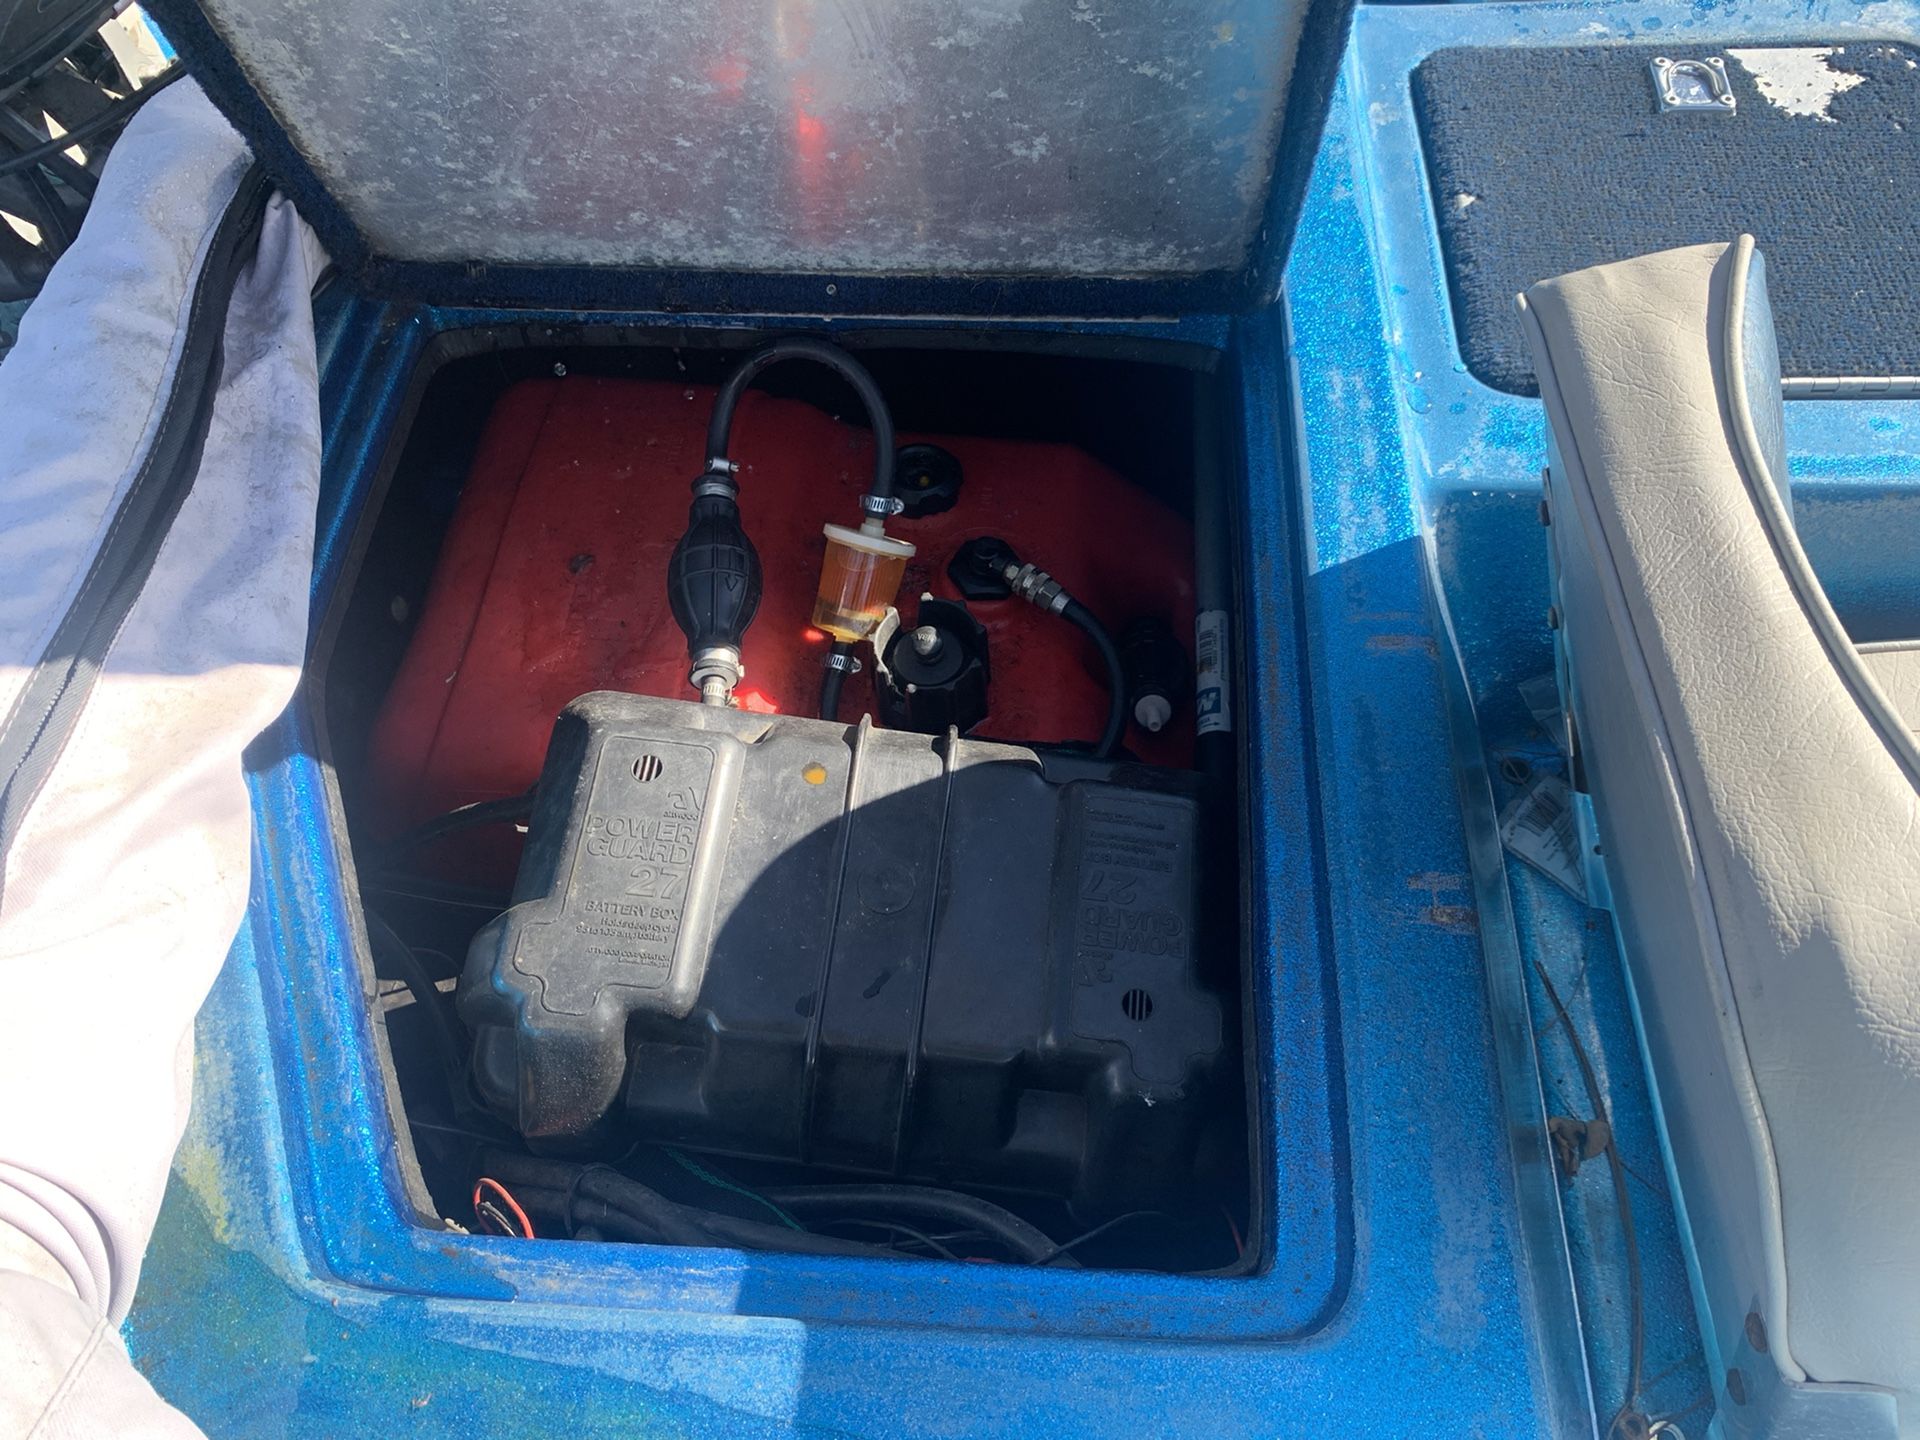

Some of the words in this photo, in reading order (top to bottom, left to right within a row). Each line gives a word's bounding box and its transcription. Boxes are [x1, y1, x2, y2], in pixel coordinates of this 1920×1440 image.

[585, 814, 694, 845] POWER
[587, 837, 689, 865] GUARD
[626, 867, 684, 901] 27
[1081, 870, 1138, 905] 27
[585, 900, 644, 917] BATTERY
[650, 906, 679, 921] BOX
[1081, 906, 1183, 937] GUARD
[1080, 928, 1186, 960] POWER
